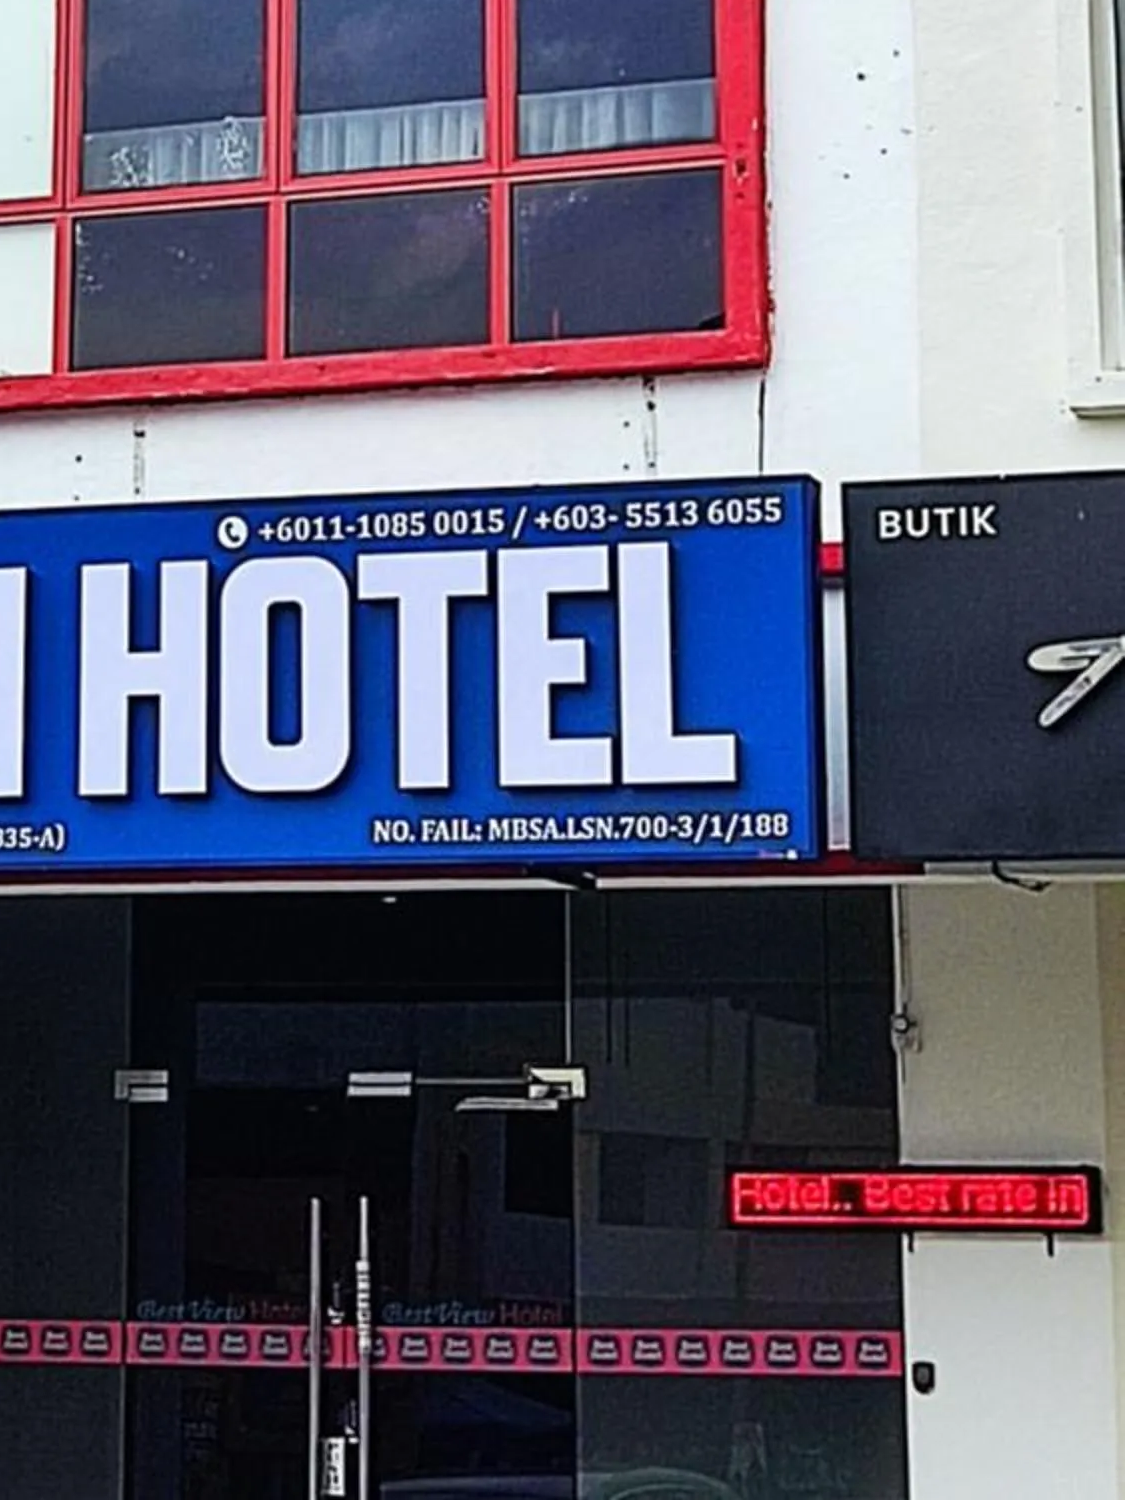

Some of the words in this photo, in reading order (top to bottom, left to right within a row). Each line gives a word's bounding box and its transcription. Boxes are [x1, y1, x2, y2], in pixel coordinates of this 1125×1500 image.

[258, 512, 426, 542] +6011-1085
[433, 508, 505, 535] 0015
[534, 504, 618, 531] +603-
[625, 500, 699, 528] 5513
[707, 496, 782, 524] 6055
[878, 504, 997, 539] BUTIK
[78, 542, 737, 797] HOTEL
[373, 819, 415, 842] NO.
[421, 818, 483, 842] FAIL:
[865, 1176, 951, 1213] Best
[962, 1176, 1038, 1213] rate
